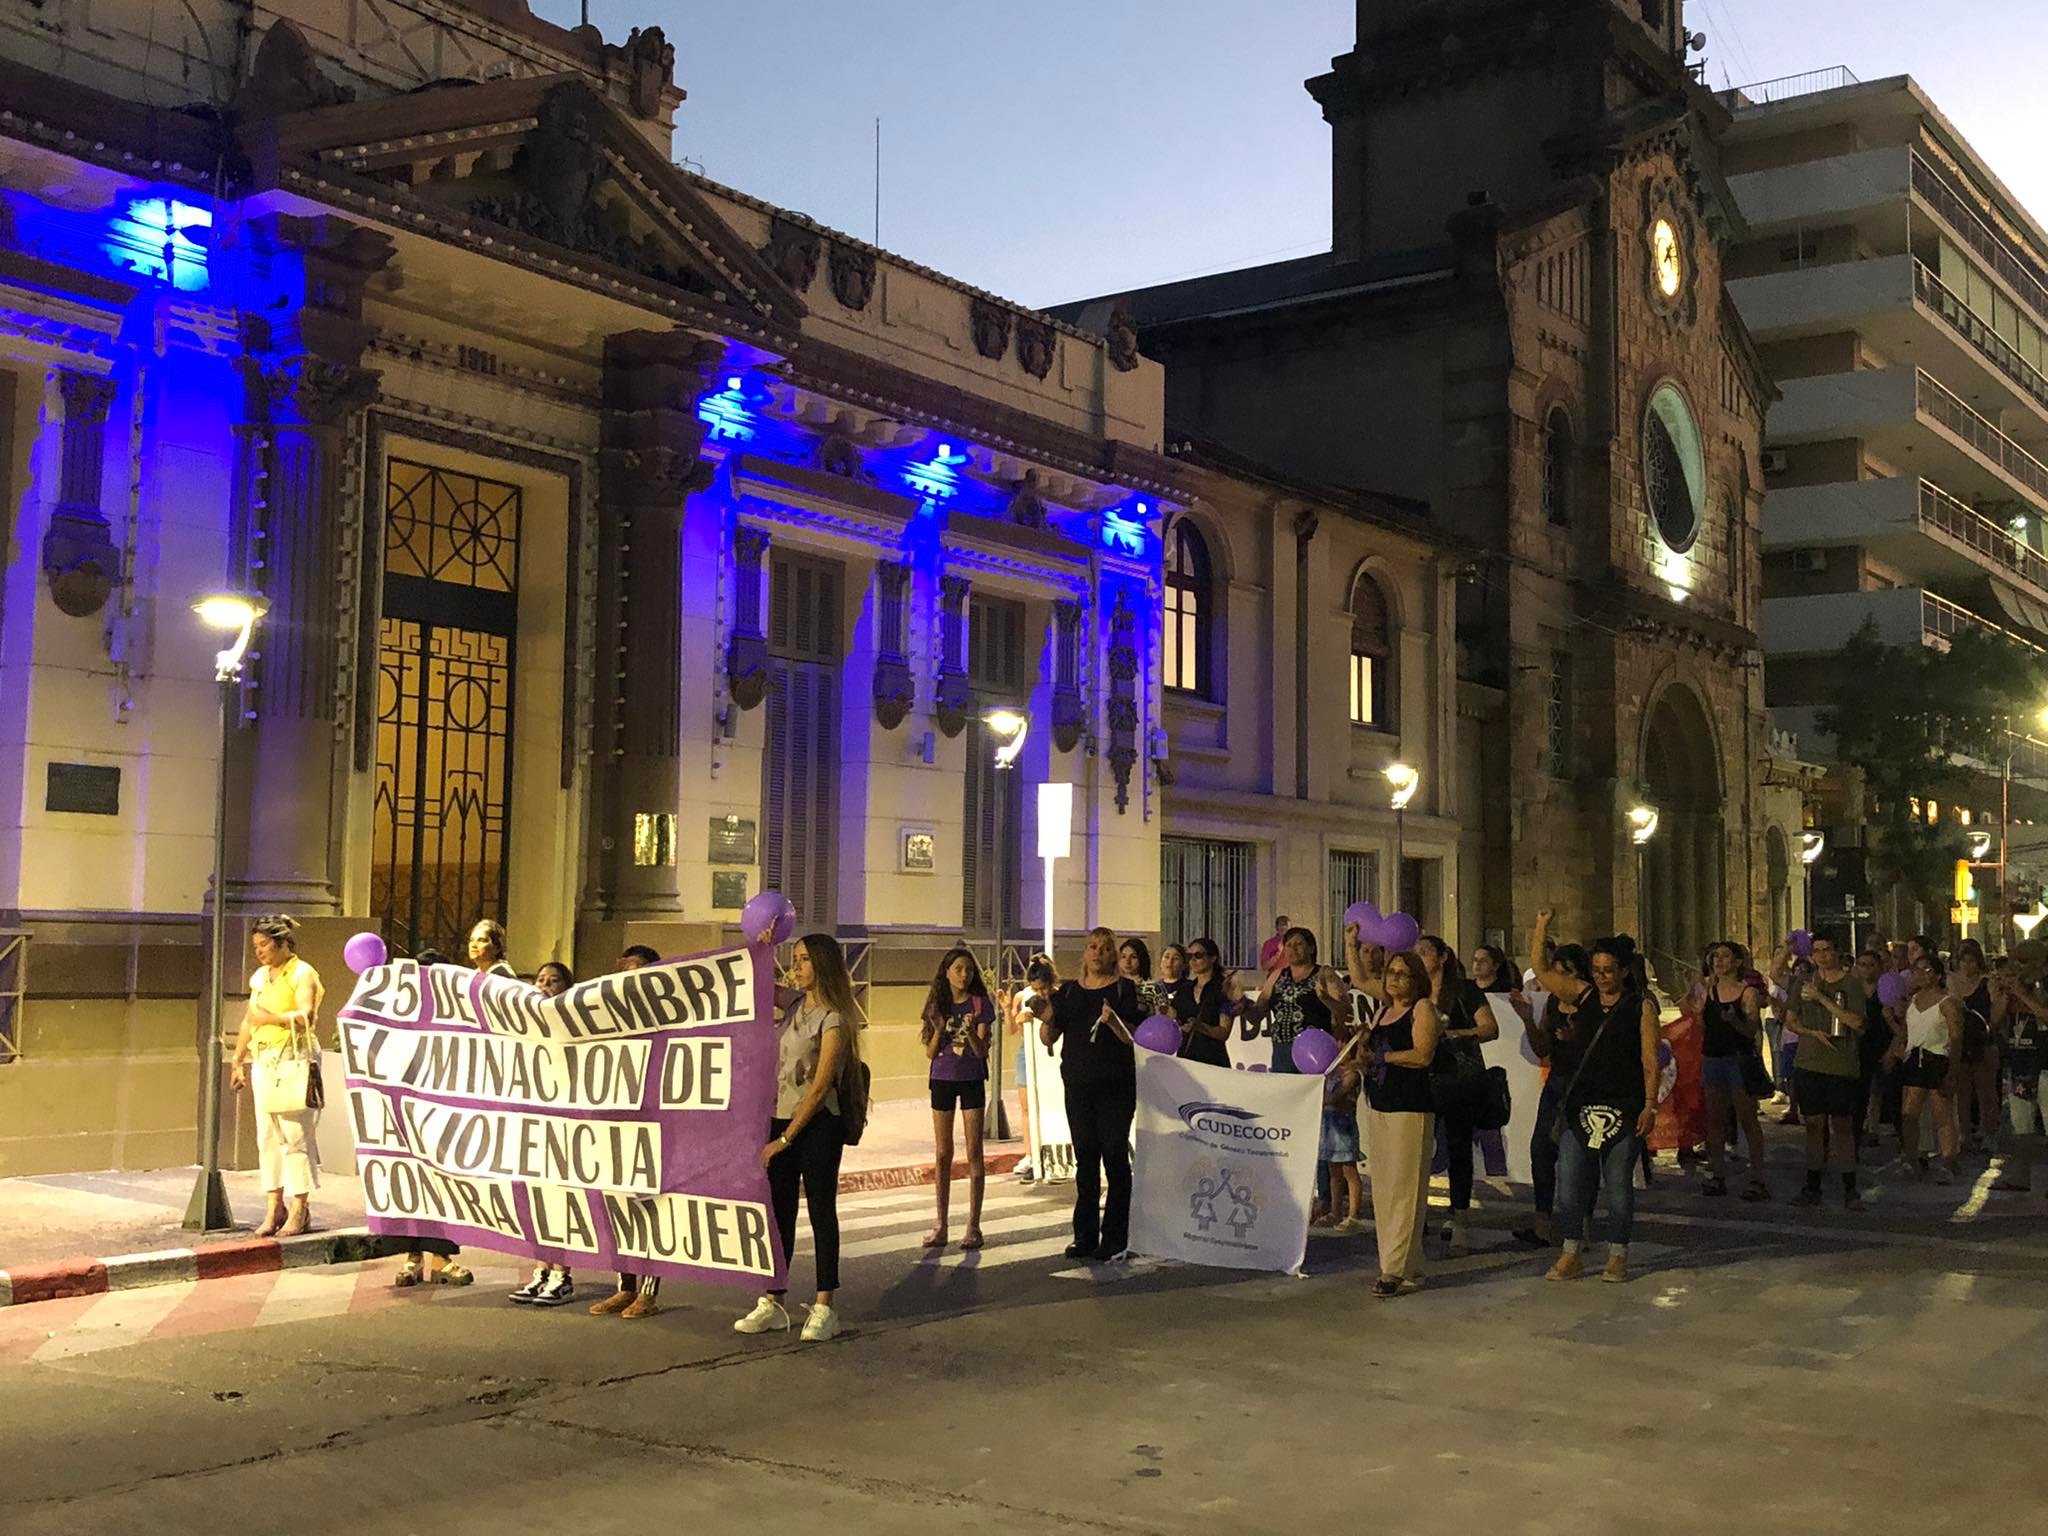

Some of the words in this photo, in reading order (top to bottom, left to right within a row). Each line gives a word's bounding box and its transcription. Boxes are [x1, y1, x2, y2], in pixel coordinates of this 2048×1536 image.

[353, 962, 418, 1016] 25
[430, 968, 476, 1024] DE
[482, 954, 750, 1038] NOVIEMBRE
[662, 1042, 725, 1105] DE
[351, 1092, 407, 1148] LA
[404, 1101, 657, 1188] VIOLENCIA
[1197, 1118, 1291, 1141] CUDECOOP
[364, 1159, 522, 1236] CONTRA
[532, 1186, 595, 1247] LA
[604, 1194, 771, 1271] MUJER
